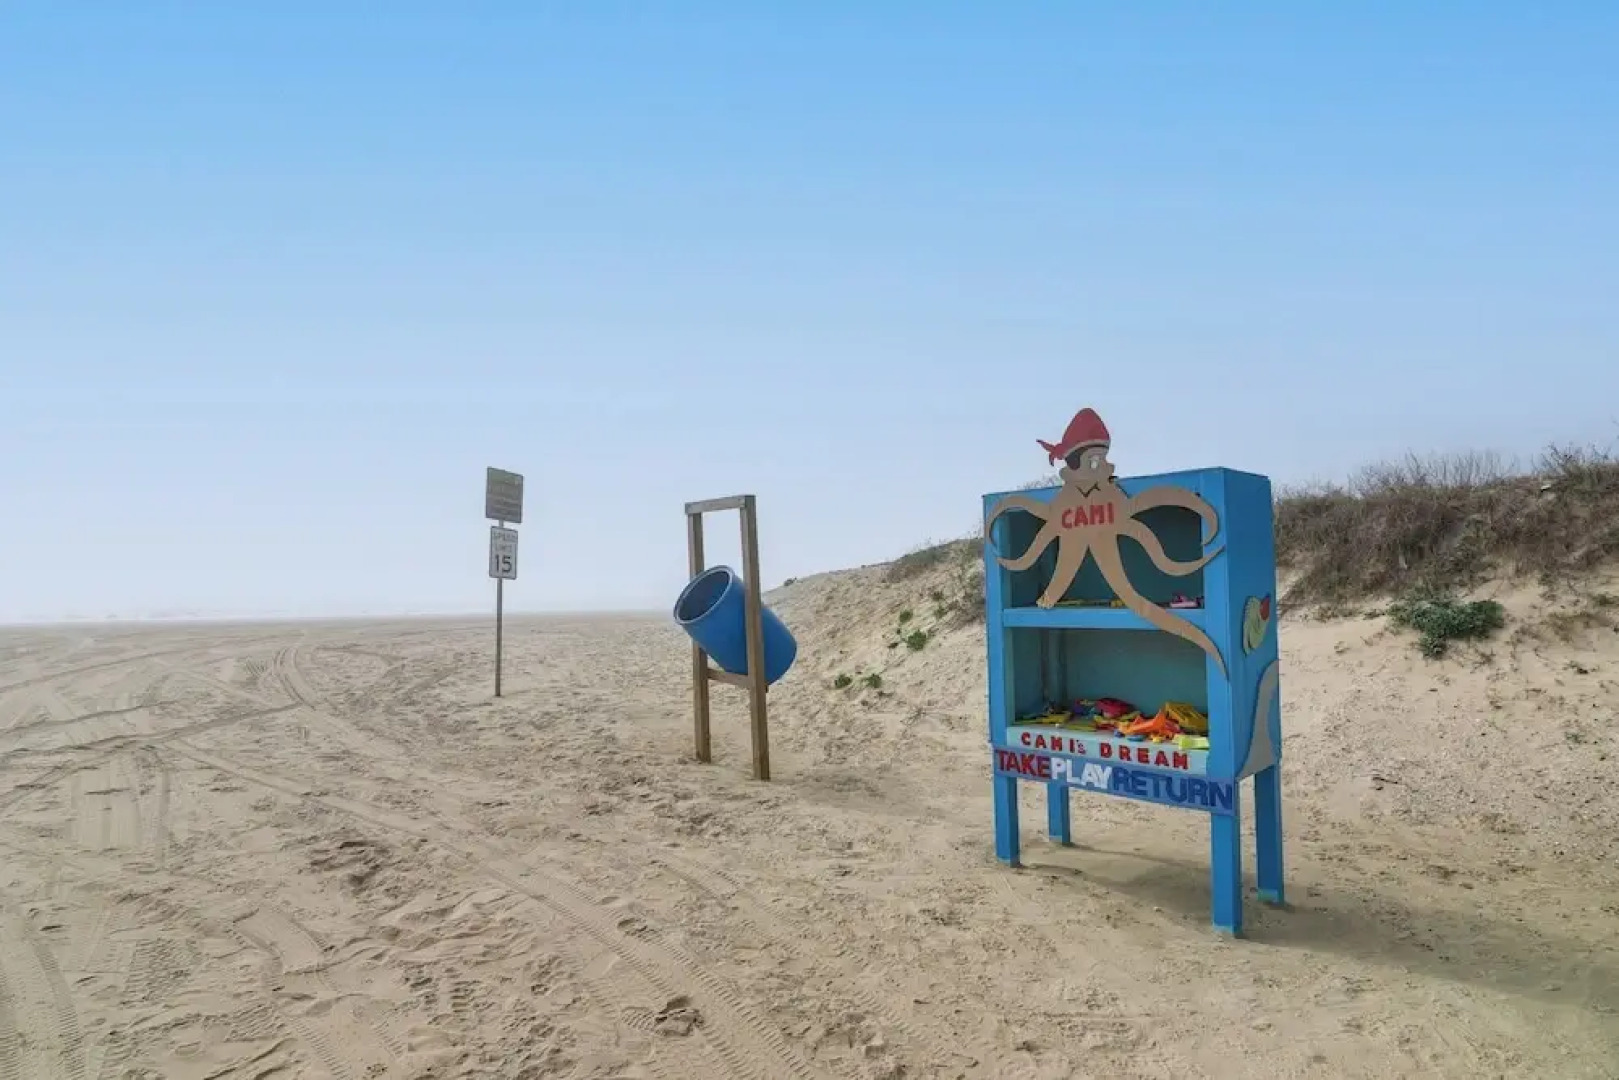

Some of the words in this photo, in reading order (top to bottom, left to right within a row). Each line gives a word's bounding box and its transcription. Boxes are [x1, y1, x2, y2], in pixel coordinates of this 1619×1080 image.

[1062, 502, 1114, 528] CAMI
[495, 554, 512, 573] 15
[1099, 742, 1190, 770] DREAM
[997, 749, 1051, 778] TAKE
[1050, 757, 1113, 790] PLAY
[1112, 767, 1233, 810] RETURN
